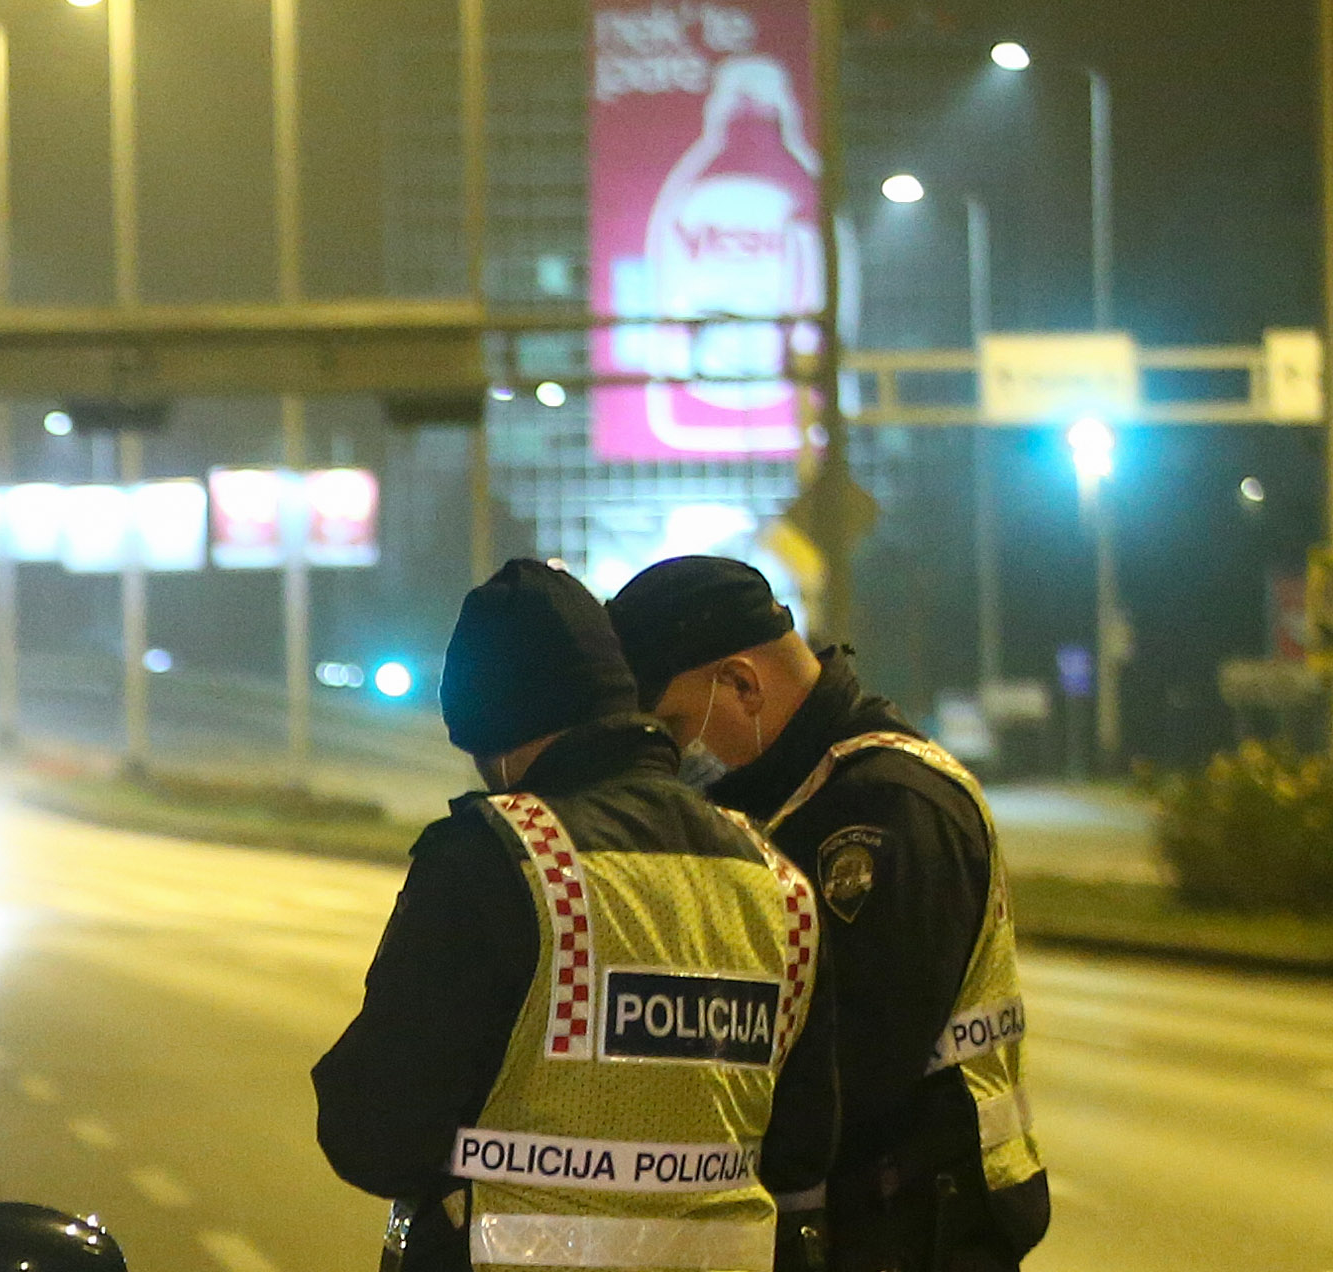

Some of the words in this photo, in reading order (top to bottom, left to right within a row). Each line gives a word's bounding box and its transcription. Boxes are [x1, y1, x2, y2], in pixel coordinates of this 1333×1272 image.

[614, 992, 770, 1045] POLICIJA
[460, 1137, 617, 1180] POLICIJA
[633, 1148, 750, 1183] POLICIJA
